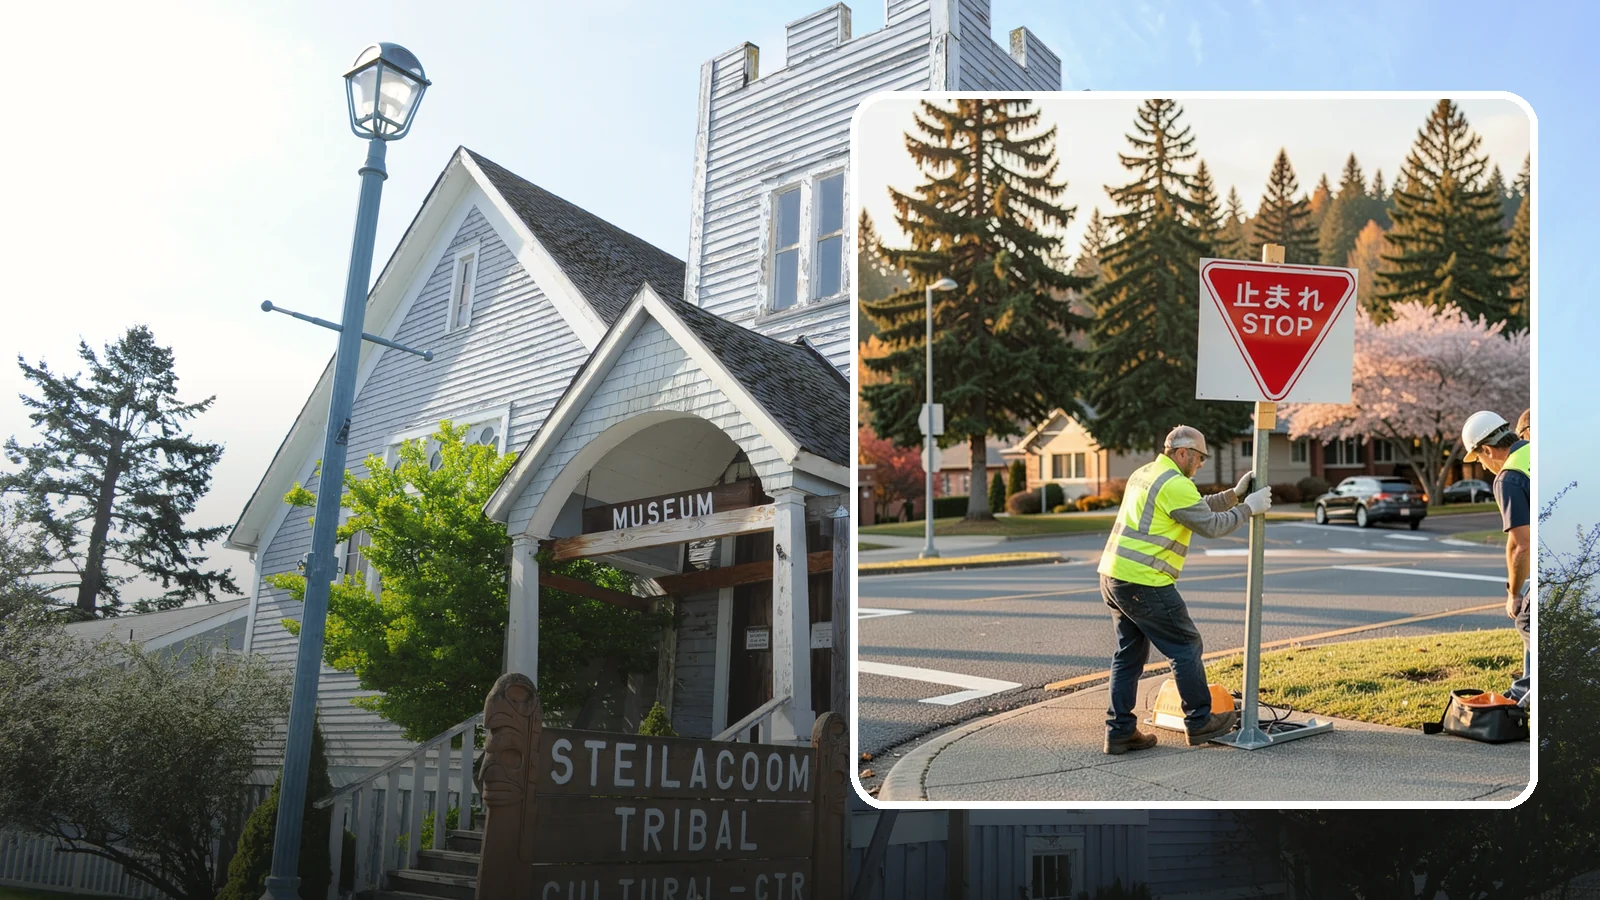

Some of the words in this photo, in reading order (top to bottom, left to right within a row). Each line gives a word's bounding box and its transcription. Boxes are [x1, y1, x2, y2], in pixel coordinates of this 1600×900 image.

[1233, 281, 1325, 312] 止まれ
[1242, 313, 1313, 336] STOP
[613, 491, 713, 530] MUSEUM
[551, 738, 809, 792] STEILACOOM
[615, 807, 757, 851] TRIBAL
